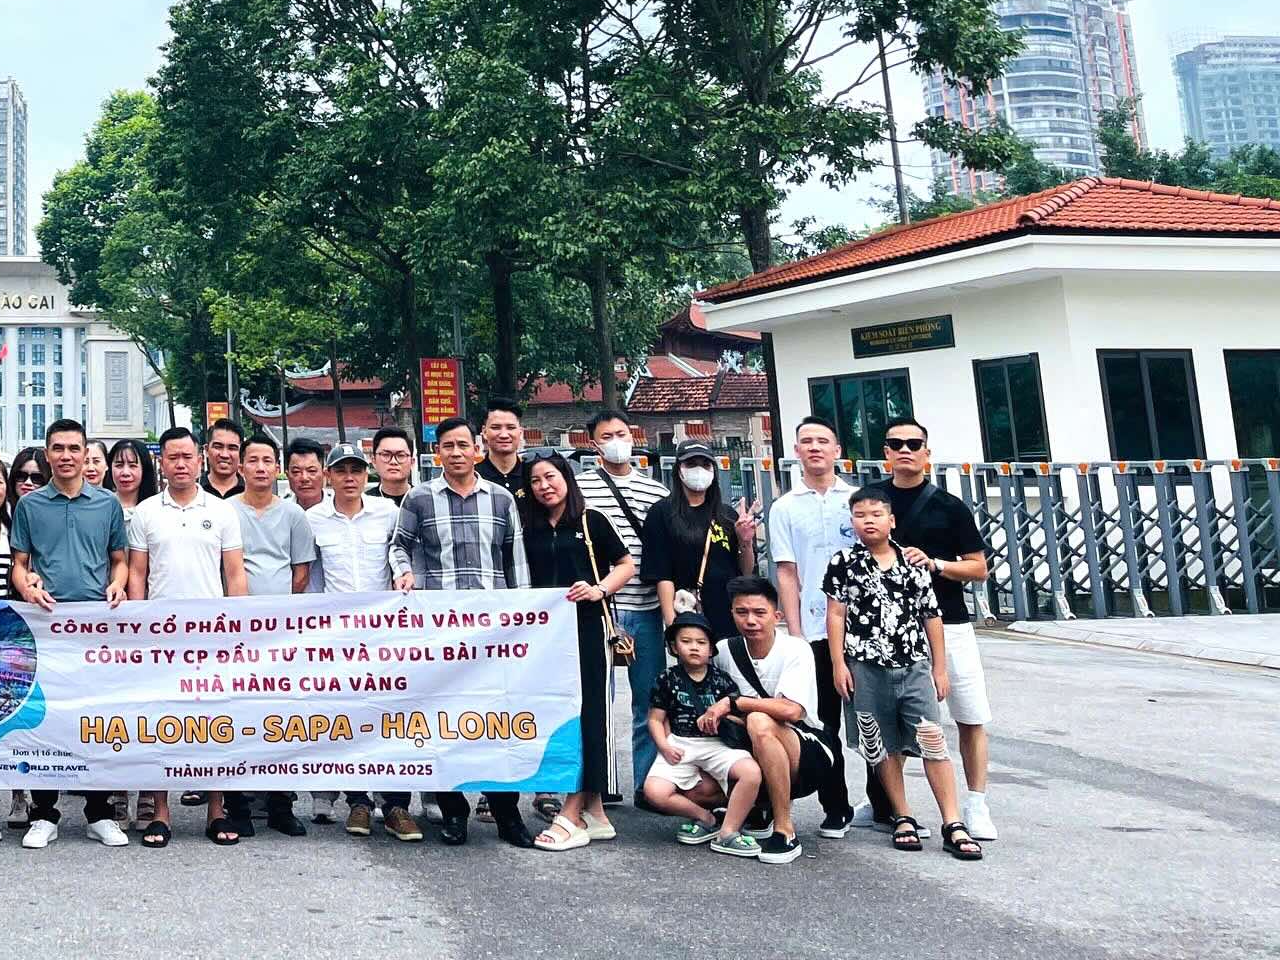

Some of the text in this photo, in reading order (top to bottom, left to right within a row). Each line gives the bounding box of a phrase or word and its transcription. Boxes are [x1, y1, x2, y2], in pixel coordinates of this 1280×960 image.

[50, 607, 550, 634] CÔNG TY CỔ PHẦN DU LỊCH THUYỀN VÀNG 9999
[84, 642, 529, 664] CÔNG TY CP ĐẦU TƯ TM VÀ DVDL BÀI THƠ
[180, 673, 407, 692] NHÀ HÀNG CUA VÀNG
[80, 711, 538, 752] HẠ LONG - SAPA - HẠ LONG
[51, 764, 90, 772] TRAVEL
[164, 761, 433, 778] THÀNH PHỐ TRONG SƯƠNG SAPA 2025
